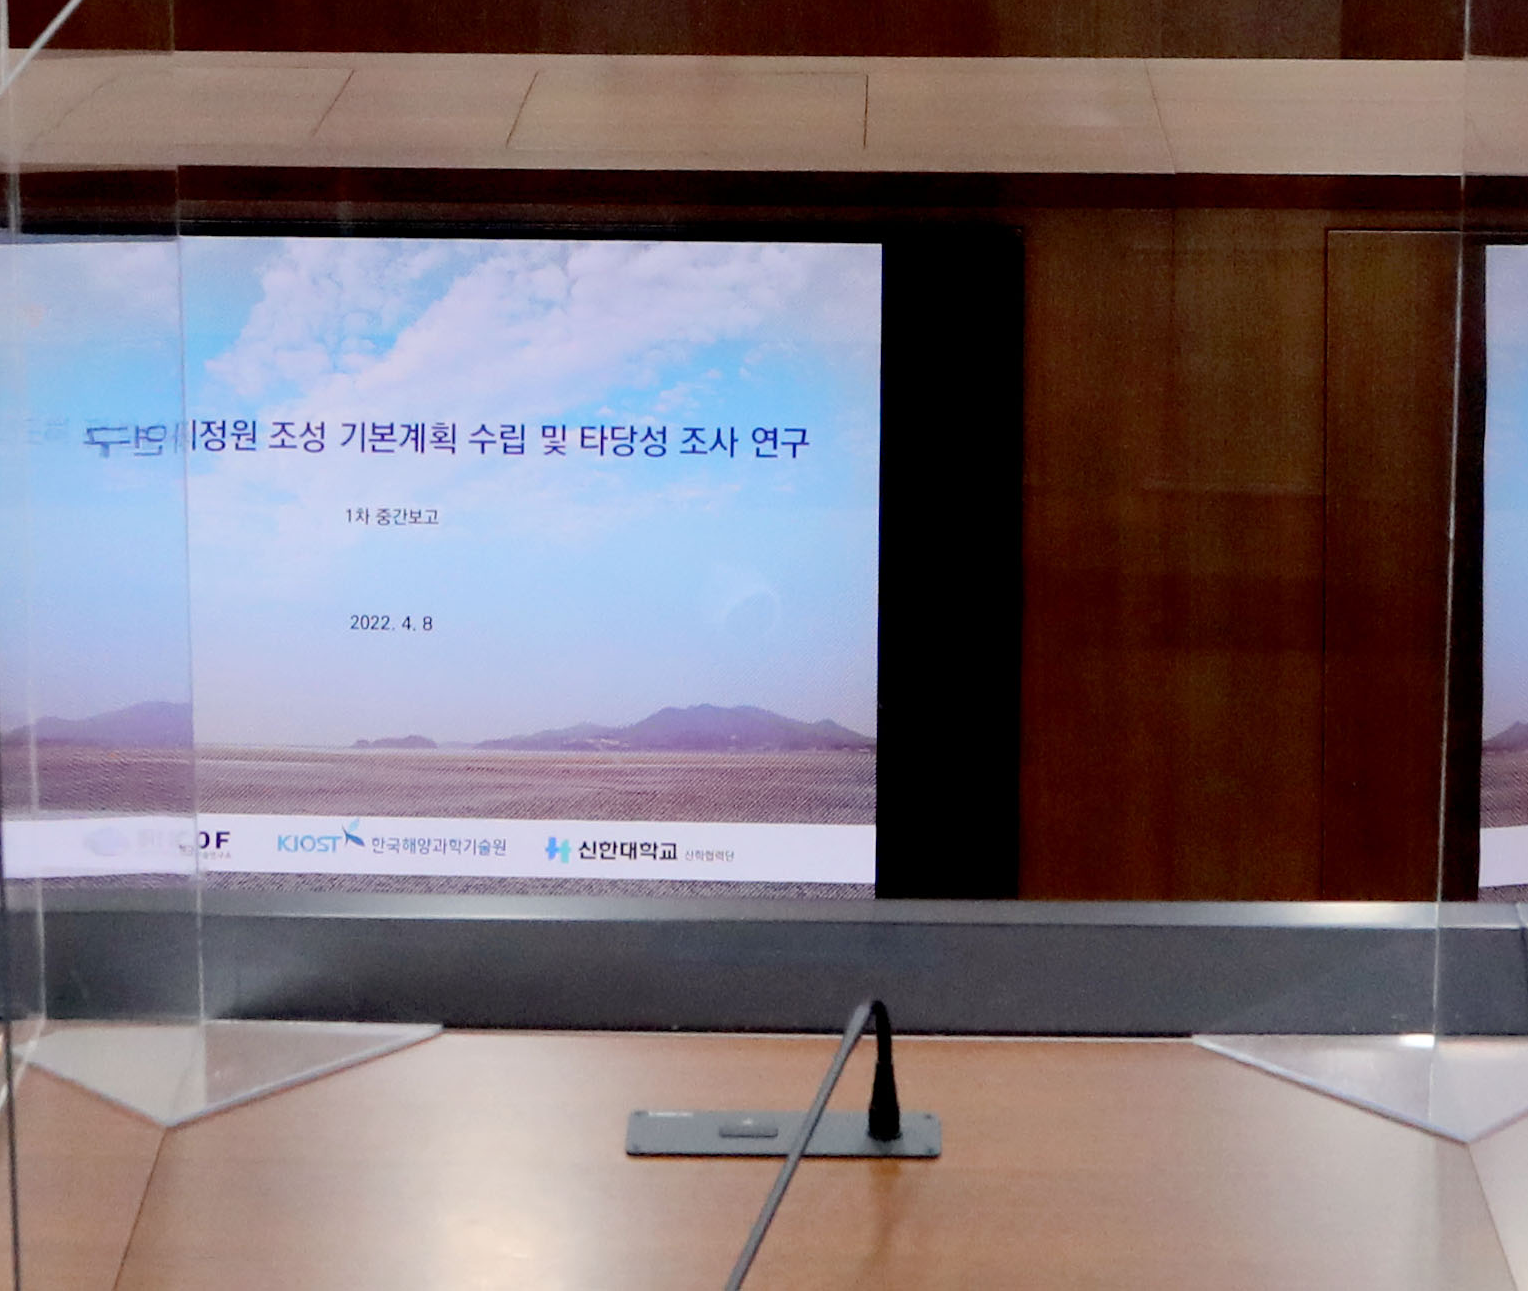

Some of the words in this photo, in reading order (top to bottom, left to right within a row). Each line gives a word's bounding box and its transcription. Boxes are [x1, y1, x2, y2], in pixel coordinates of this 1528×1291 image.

[269, 421, 326, 454] 조성
[340, 421, 456, 455] 기본계획
[468, 423, 526, 456] 수립
[541, 423, 567, 456] 및
[580, 424, 668, 458] 타당성
[679, 426, 739, 459] 조사
[751, 426, 810, 459] 연구
[346, 508, 370, 526] 1차
[375, 508, 439, 527] 중간보고
[350, 614, 396, 631] 2022.
[401, 615, 417, 632] 4.
[422, 615, 433, 632] 8
[371, 836, 507, 857] 한국해양과학기술원
[578, 840, 678, 861] 신한대학교
